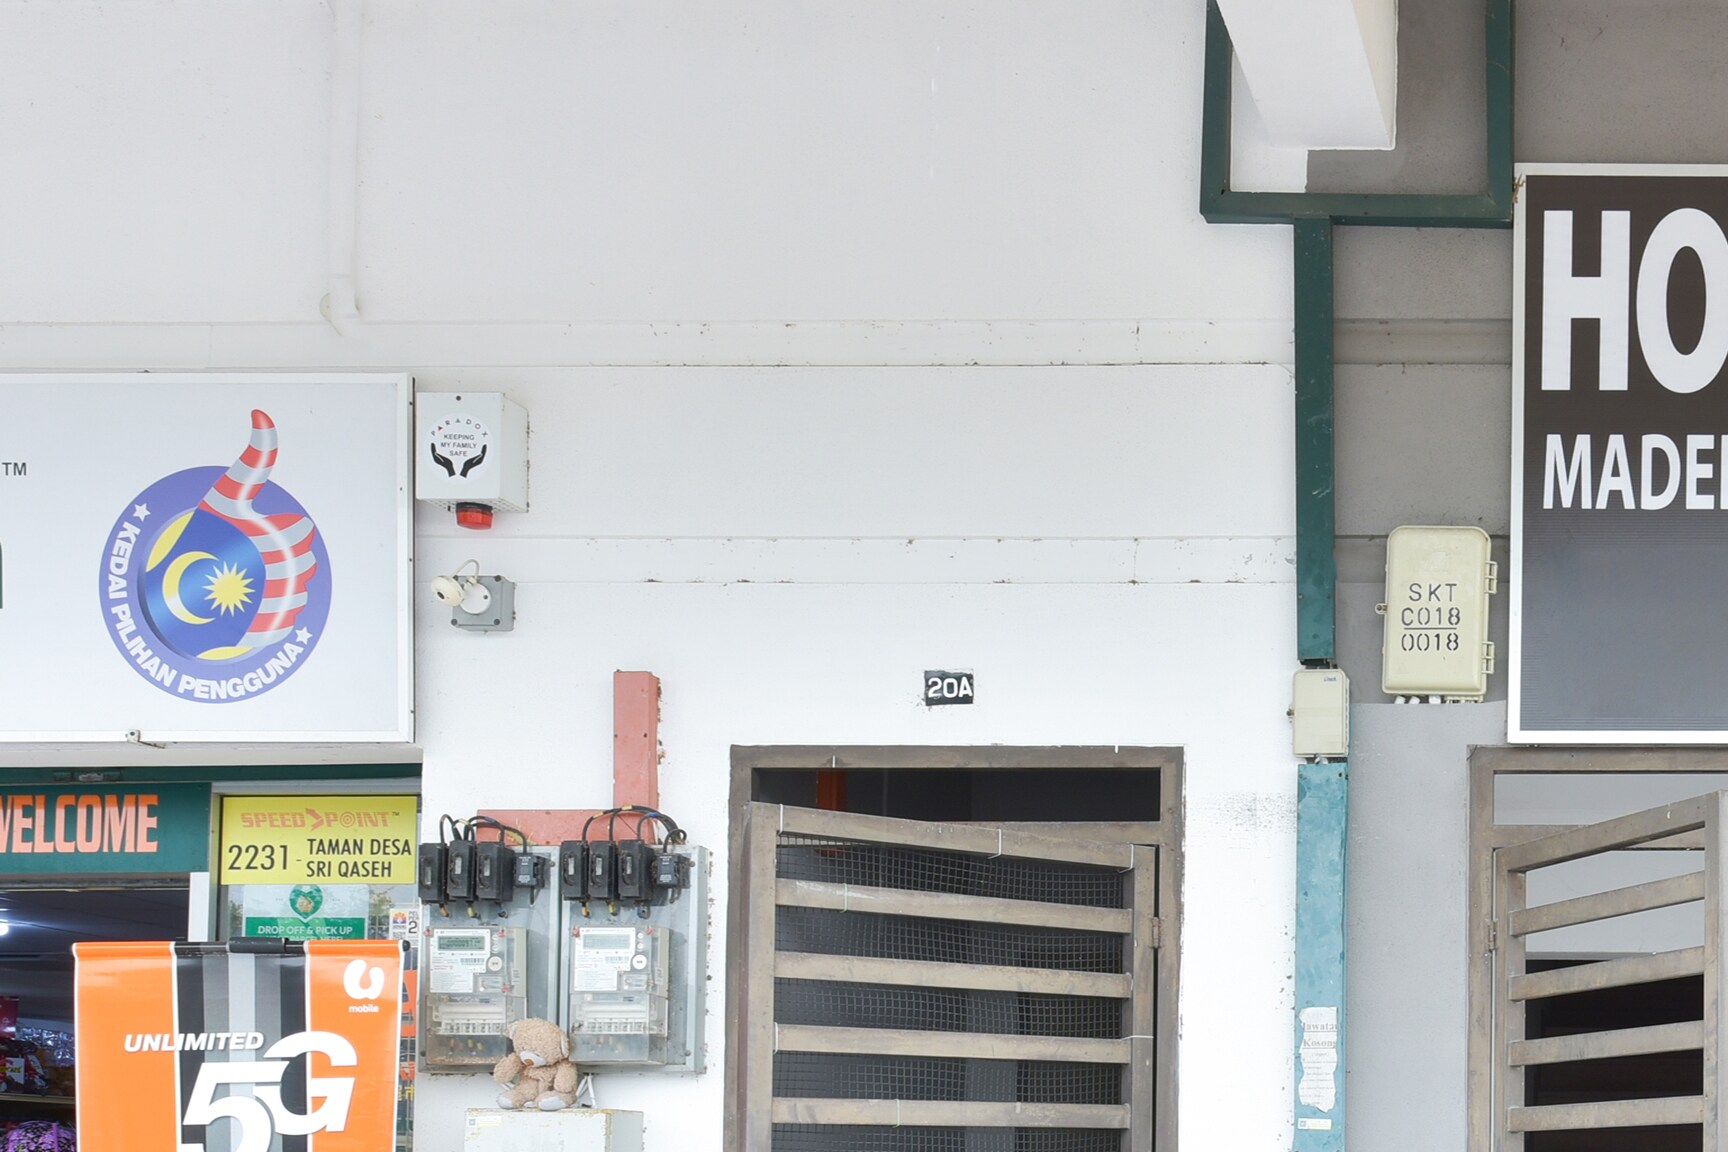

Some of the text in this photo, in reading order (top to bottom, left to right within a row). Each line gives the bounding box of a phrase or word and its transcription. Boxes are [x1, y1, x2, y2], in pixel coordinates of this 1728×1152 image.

[2, 462, 28, 476] TM
[1408, 582, 1457, 602] SKT
[107, 521, 305, 700] KEDAI PILIHAN PENGGUNA
[1401, 607, 1461, 626] C018
[1401, 632, 1459, 651] 0018
[928, 676, 973, 698] 20A
[241, 811, 306, 828] SPEED
[228, 844, 288, 870] 2231
[306, 838, 363, 856] TAMAN
[370, 838, 411, 856] DESA
[306, 860, 392, 878] SRI QASEH
[258, 926, 285, 935] DROP
[287, 926, 306, 935] OFF
[315, 926, 337, 935] PICK
[339, 926, 353, 935] UP
[349, 1004, 379, 1013] mobile
[124, 1031, 264, 1052] UNLIMITED
